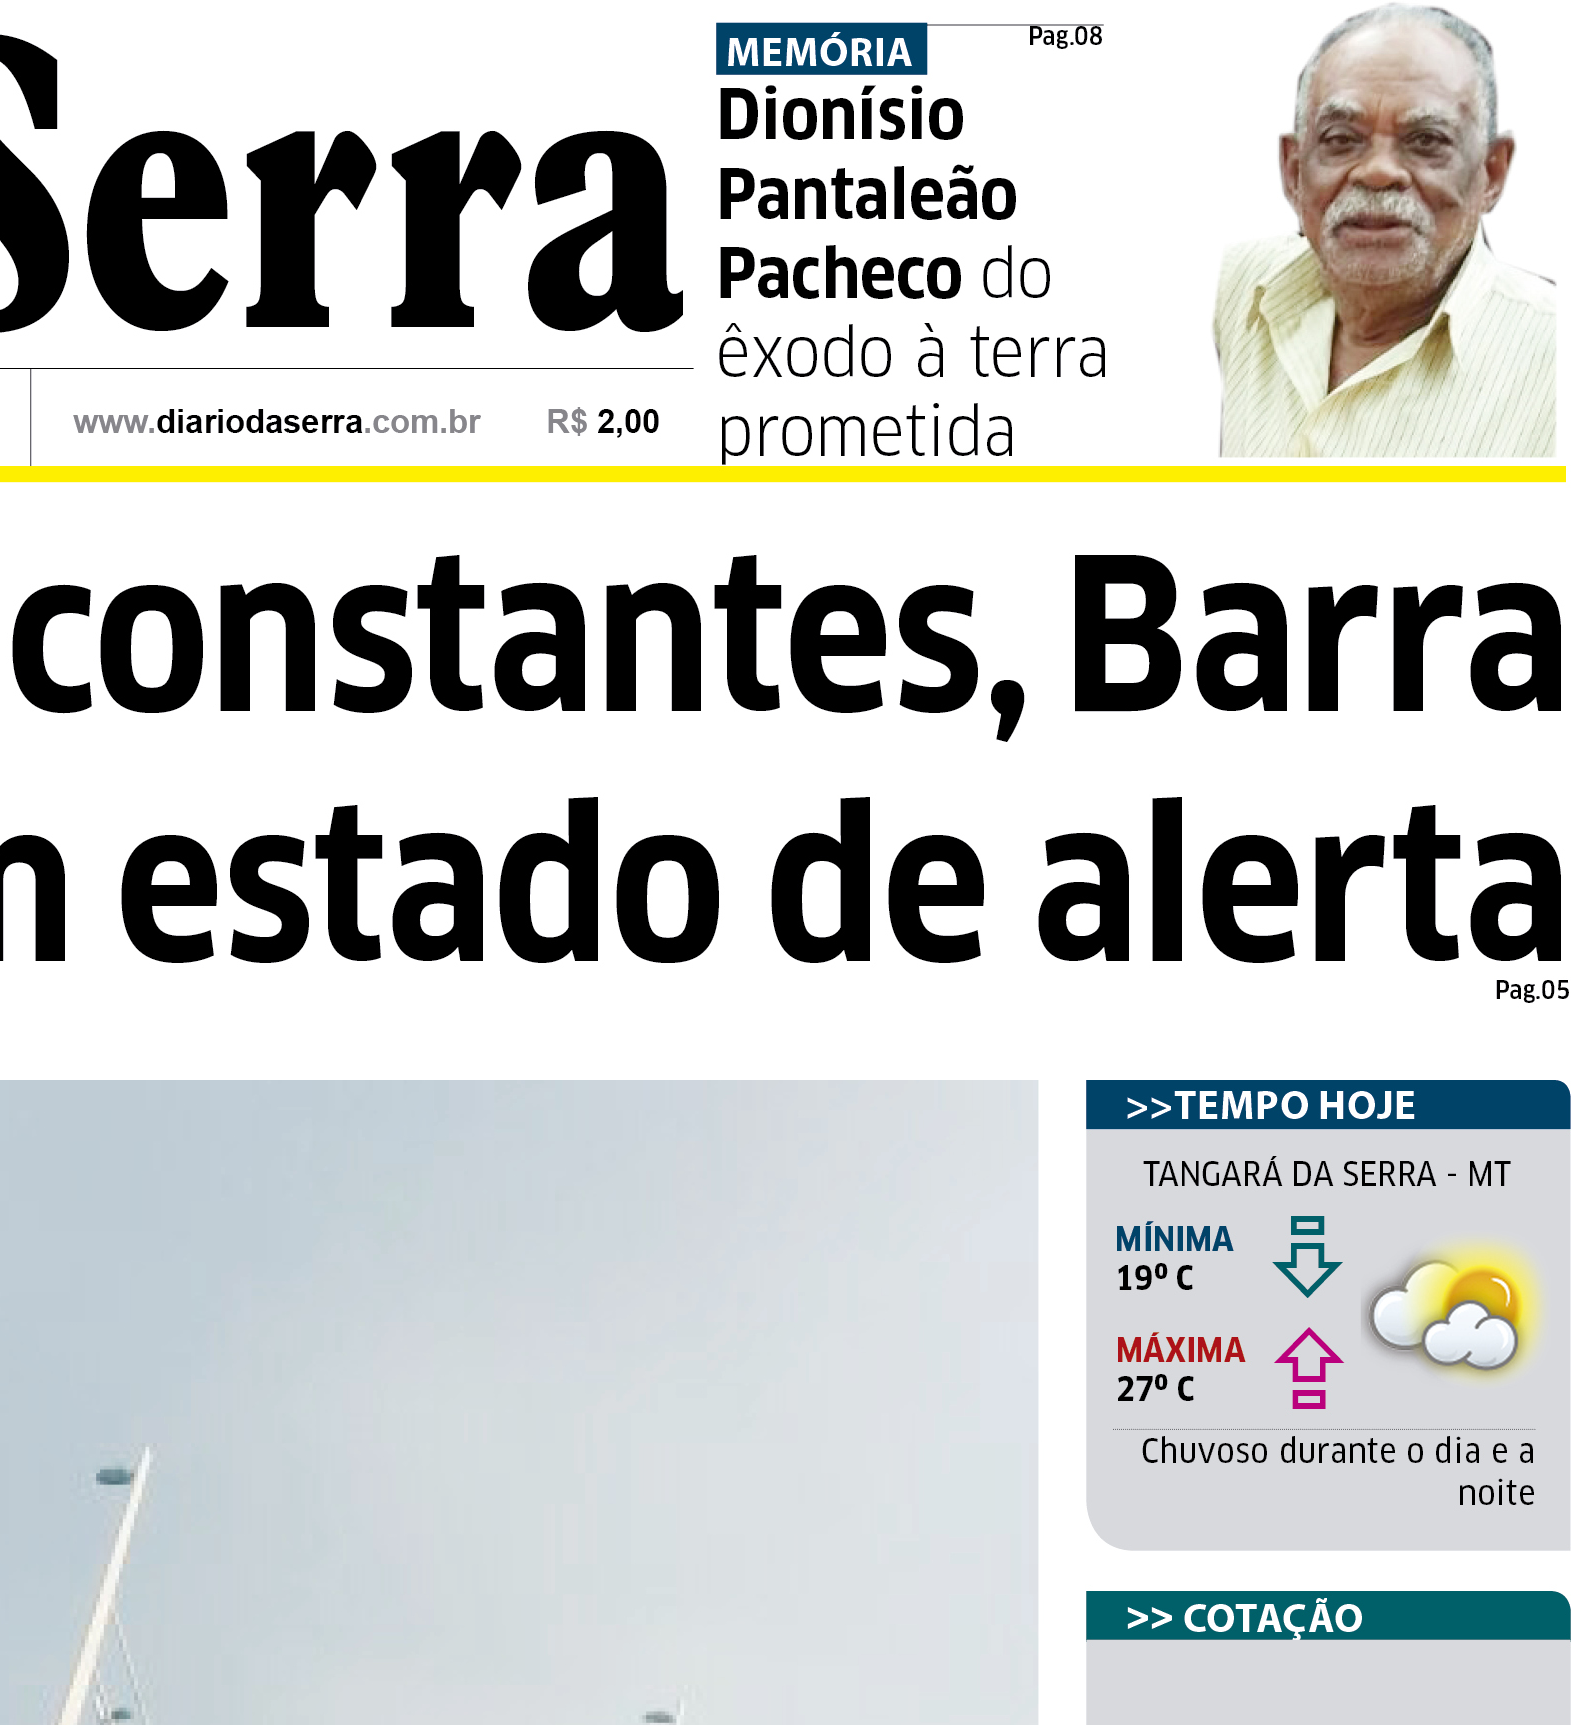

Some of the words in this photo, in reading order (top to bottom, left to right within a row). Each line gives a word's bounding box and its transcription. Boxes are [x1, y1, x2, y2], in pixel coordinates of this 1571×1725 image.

[727, 31, 913, 67] MEMÓRIA
[1029, 26, 1103, 50] Pag.08
[719, 84, 964, 141] Dionísio
[719, 163, 1017, 221] Pantaleão
[719, 244, 962, 300] Pacheco
[982, 244, 1051, 299] do
[718, 322, 892, 378] êxodo
[917, 322, 944, 378] à
[969, 325, 1106, 378] terra
[72, 408, 482, 434] www.diariodaserra.com.br
[548, 406, 588, 437] R$
[597, 408, 660, 439] 2,00
[721, 402, 1013, 466] prometida
[11, 554, 1025, 743] constantes,
[1074, 554, 1562, 712] Barra
[120, 796, 720, 964] estado
[770, 796, 985, 964] de
[1037, 796, 1562, 964] alerta
[1496, 979, 1570, 1004] Pag.05
[1319, 1090, 1416, 1120] HOJE
[1116, 1220, 1235, 1252] MÍNIMA
[1176, 1264, 1194, 1291] C
[1117, 1331, 1247, 1363] MÁXIMA
[1177, 1375, 1195, 1402] C
[1183, 1597, 1363, 1639] COTAÇÃO
